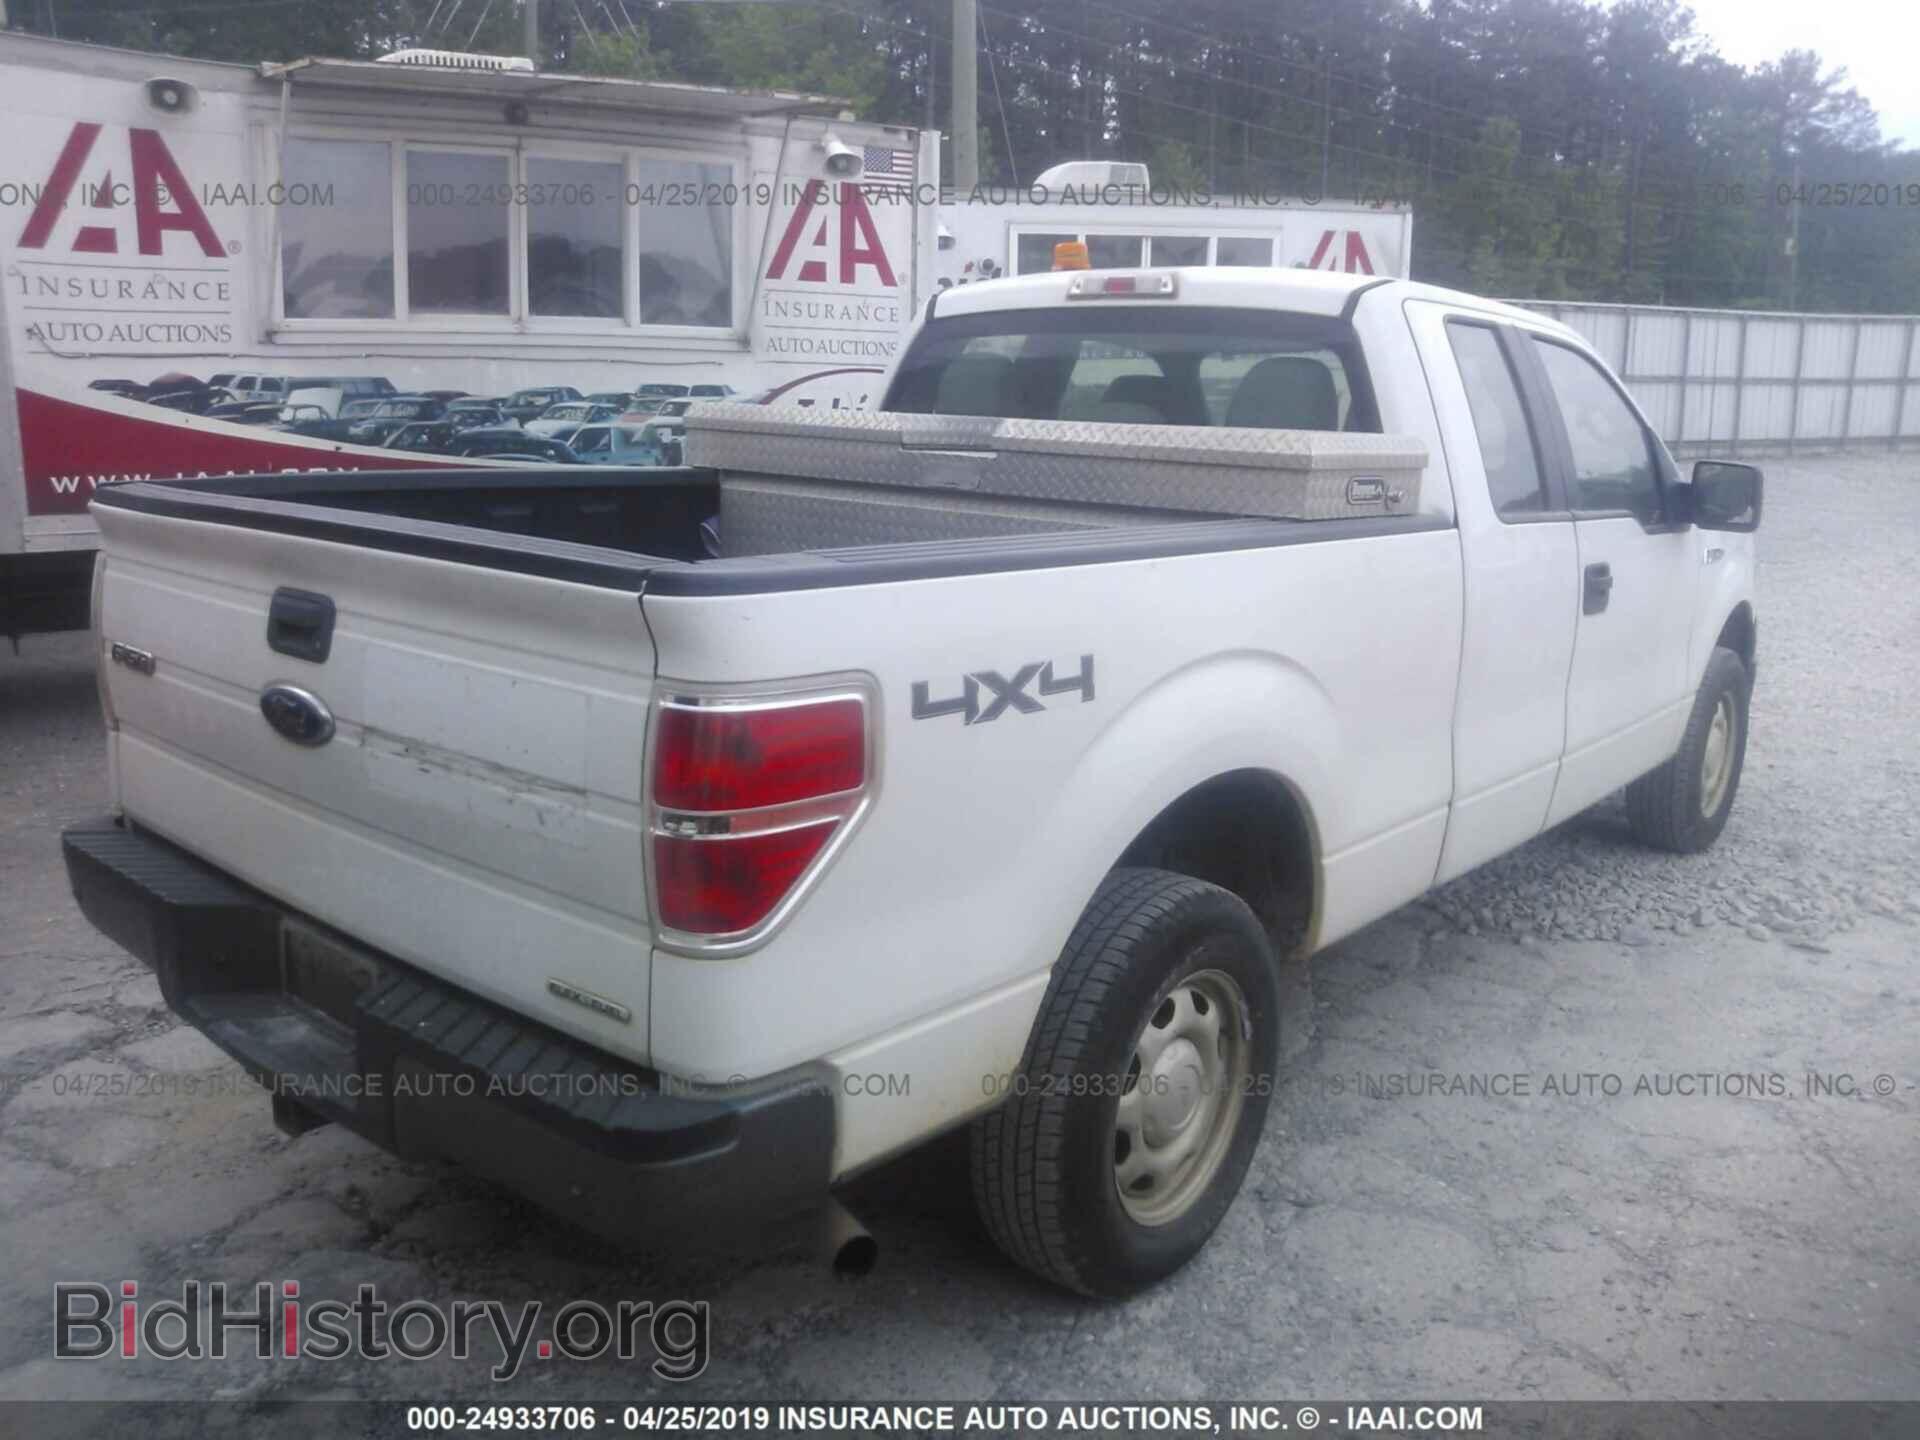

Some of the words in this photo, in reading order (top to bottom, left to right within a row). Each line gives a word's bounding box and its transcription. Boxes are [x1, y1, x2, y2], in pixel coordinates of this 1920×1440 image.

[21, 275, 231, 301] INSURANCE
[764, 300, 899, 322] INSURANCE
[26, 321, 104, 342] AUTO
[109, 323, 232, 344] AUCTIONS
[766, 336, 814, 354] AUTO
[816, 339, 897, 357] AUCTIONS
